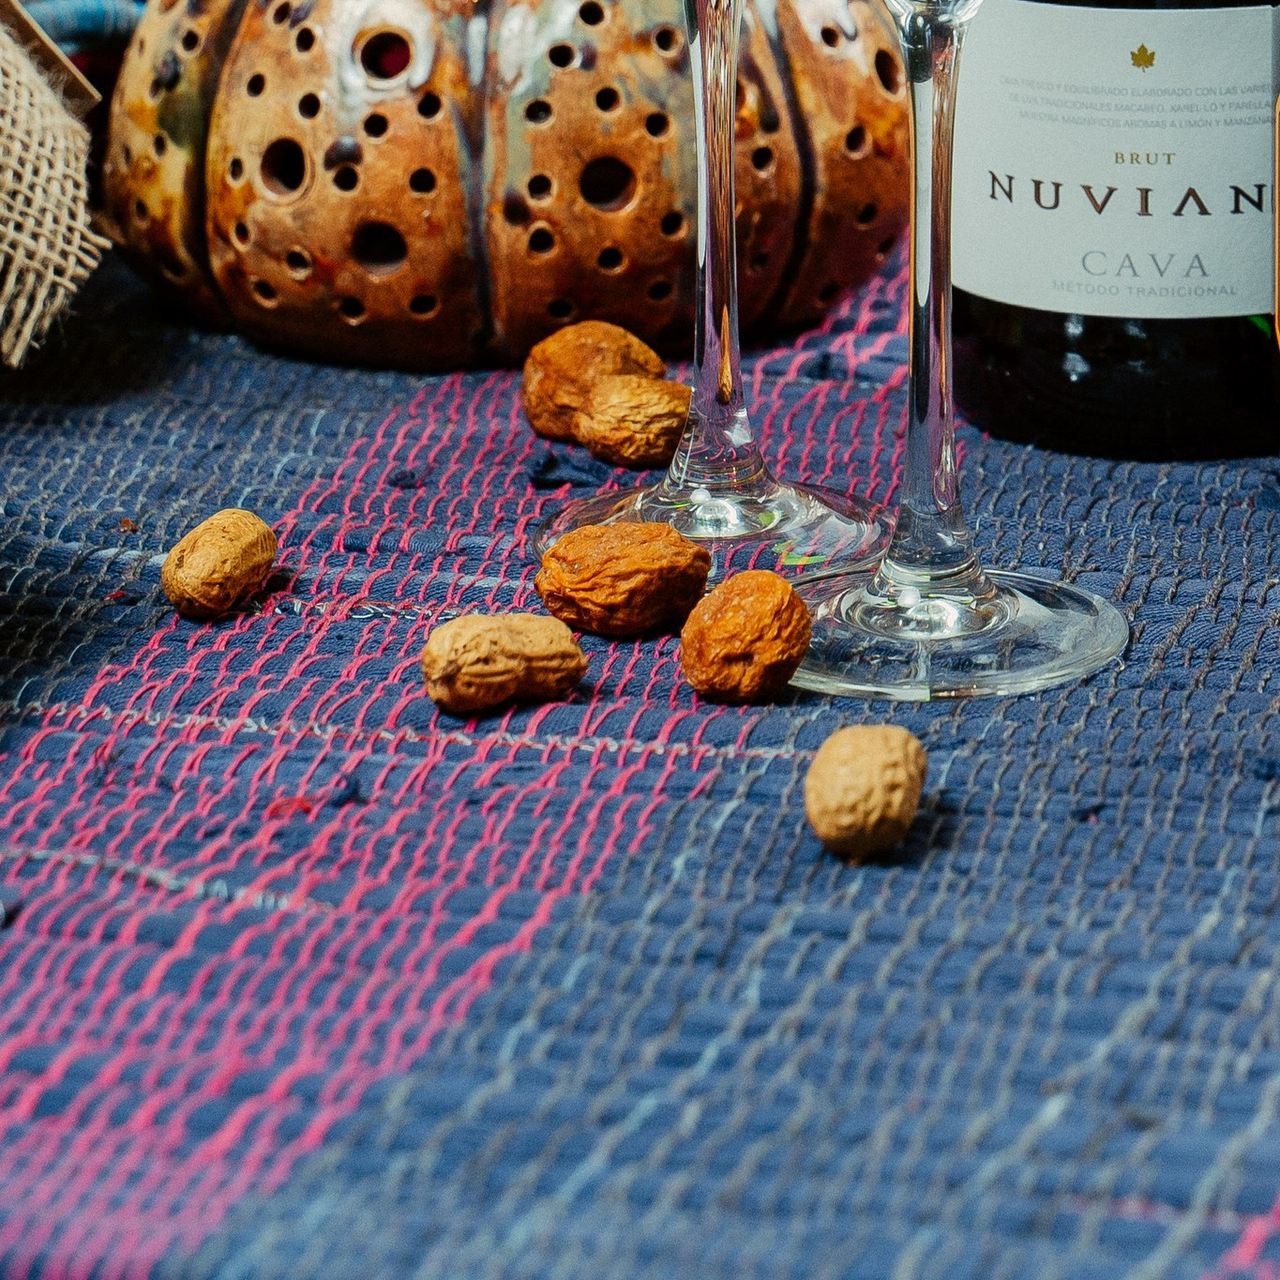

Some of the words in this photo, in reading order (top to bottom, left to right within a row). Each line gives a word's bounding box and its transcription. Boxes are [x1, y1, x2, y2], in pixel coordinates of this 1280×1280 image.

[1114, 151, 1177, 166] BRUT
[1082, 251, 1210, 278] CAVA
[1127, 285, 1237, 298] TRADICIONAL
